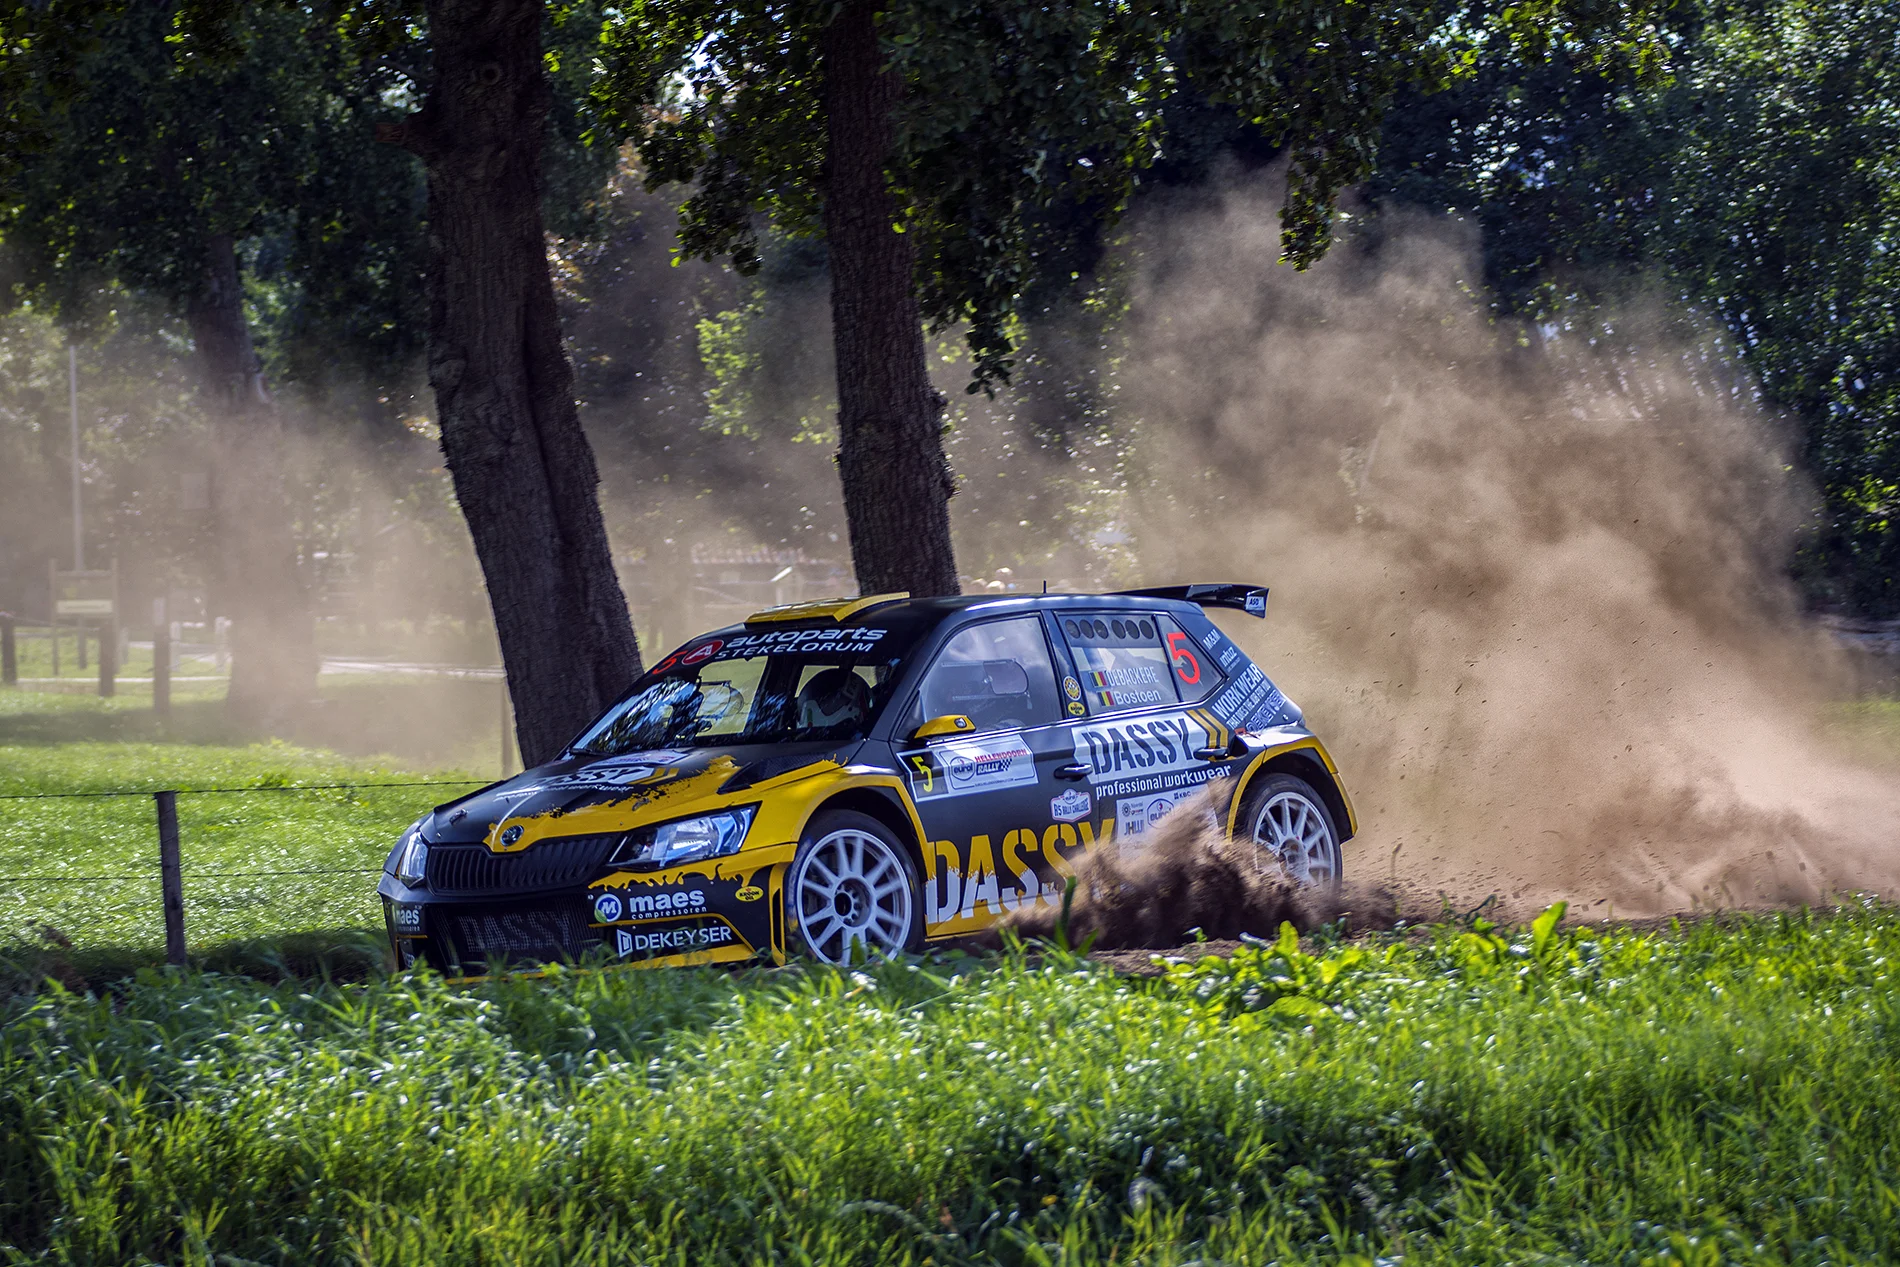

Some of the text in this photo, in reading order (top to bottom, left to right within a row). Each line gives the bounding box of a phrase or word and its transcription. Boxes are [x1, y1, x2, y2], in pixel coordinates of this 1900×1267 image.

[726, 626, 888, 649] autoparts
[1203, 629, 1221, 650] M&M
[715, 641, 874, 660] STEKELORUM
[1167, 632, 1200, 685] 5
[652, 651, 688, 675] 5
[1106, 667, 1160, 686] DEBACKERE
[1114, 689, 1162, 705] Bostoen
[1211, 663, 1264, 720] WORKWEAR
[1226, 714, 1241, 730] THAT
[974, 748, 1028, 763] HELLENDOORN
[1082, 718, 1193, 775] DASSY
[911, 755, 934, 793] 5
[977, 761, 1002, 774] RALLY
[1096, 765, 1232, 800] professional workwear
[629, 889, 706, 913] maes
[631, 906, 708, 920] compressoren
[635, 926, 733, 951] DEKEYSER
